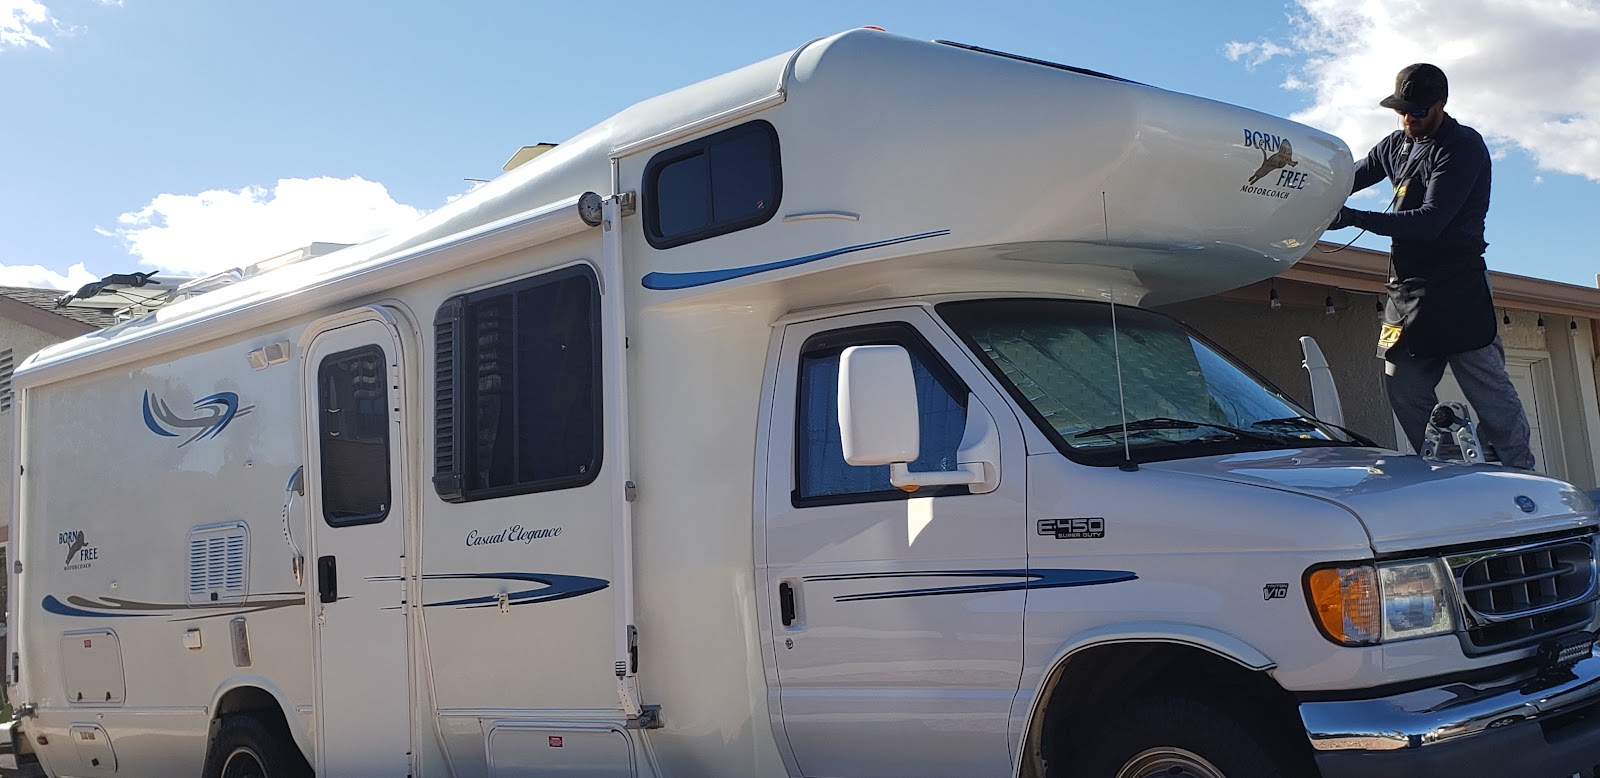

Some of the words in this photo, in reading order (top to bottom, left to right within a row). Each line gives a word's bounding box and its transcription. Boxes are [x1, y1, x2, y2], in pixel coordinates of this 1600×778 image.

[1243, 128, 1280, 152] BORN
[1276, 169, 1308, 190] FREE
[1240, 184, 1290, 199] MOTORCOACH
[58, 530, 78, 545] BORN
[466, 529, 507, 547] Casual
[507, 524, 562, 544] Elegance
[80, 547, 98, 561] FREE
[1263, 587, 1287, 600] V10
